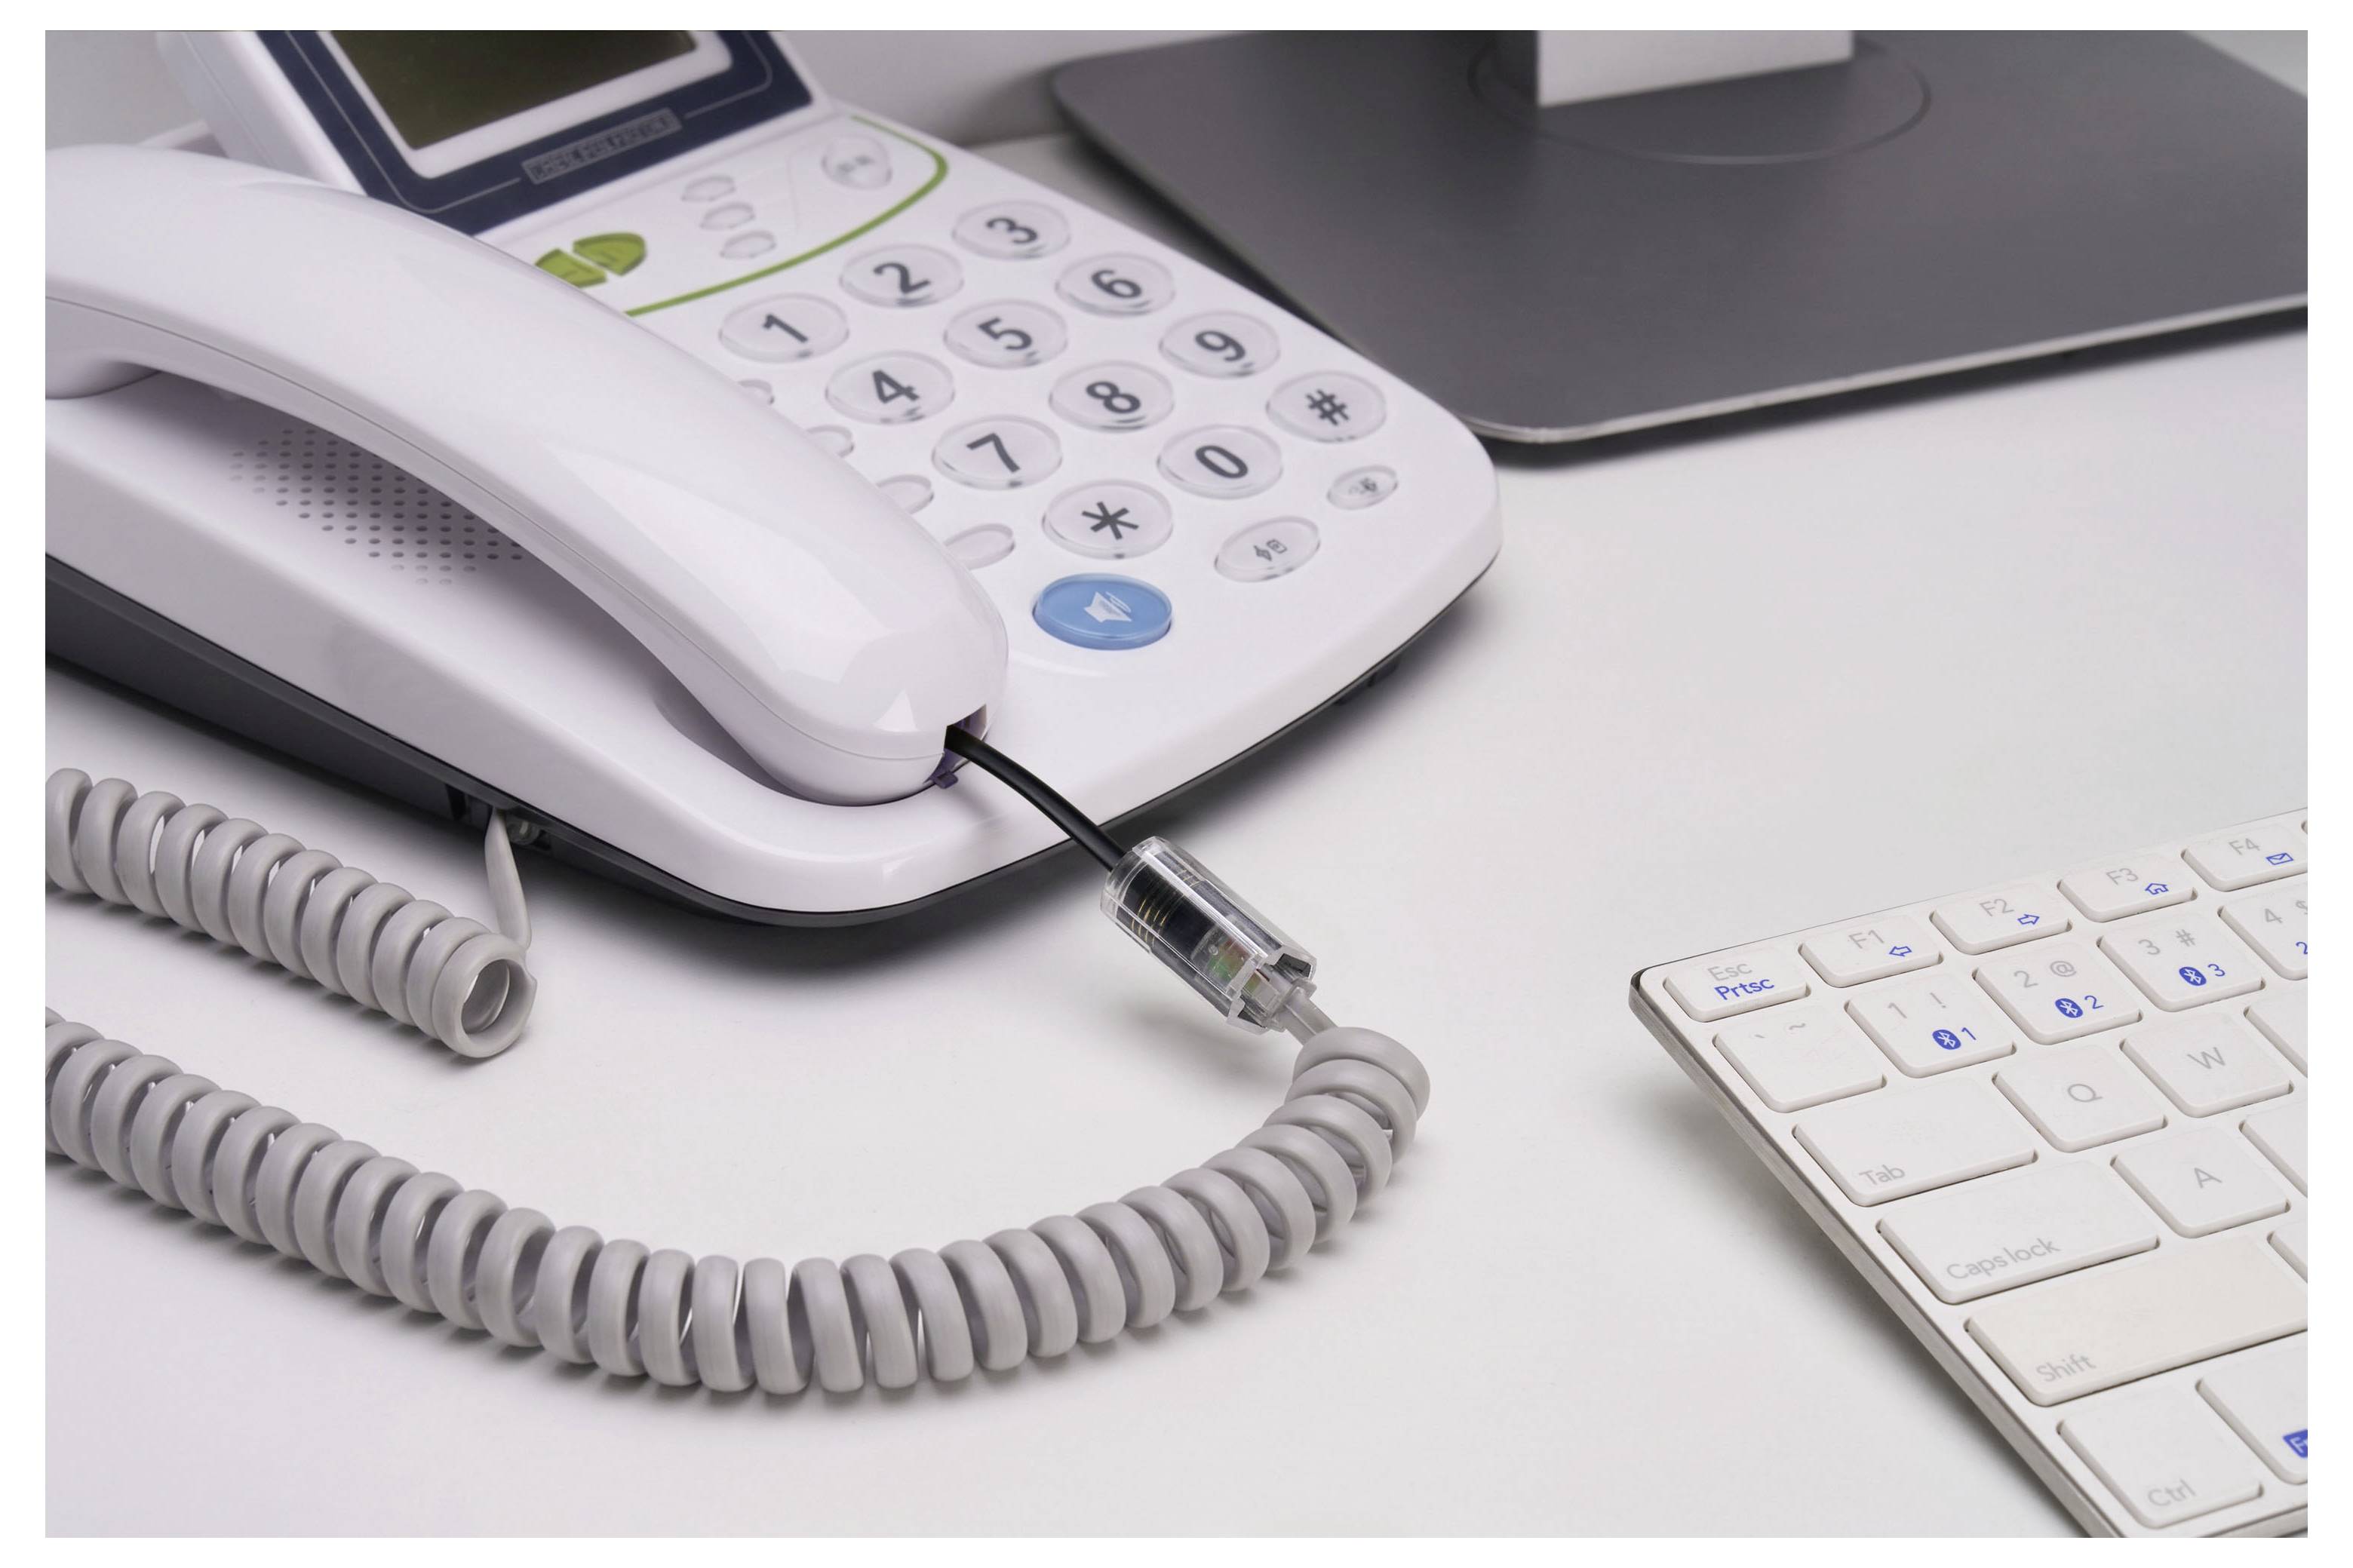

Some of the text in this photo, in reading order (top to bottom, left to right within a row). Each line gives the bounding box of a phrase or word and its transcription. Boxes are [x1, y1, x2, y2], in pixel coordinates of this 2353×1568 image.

[986, 217, 1038, 244] 3
[873, 262, 930, 295] 2
[1091, 270, 1142, 299] 6
[763, 314, 808, 343] 1
[978, 317, 1033, 351] 5
[1195, 330, 1246, 362] 9
[872, 370, 920, 404] 4
[1086, 381, 1141, 414] 8
[1307, 390, 1349, 426] #
[966, 432, 1021, 473] 7
[1195, 445, 1249, 479] 0
[2228, 838, 2260, 855] F4
[2106, 867, 2139, 885] F3
[1979, 898, 2015, 918] F2
[2264, 908, 2283, 924] 4
[1848, 929, 1885, 950] F1
[2138, 928, 2195, 956] 3 #
[1707, 963, 1752, 982] Esc
[2014, 959, 2077, 989] 2 @
[2207, 963, 2226, 977] 3
[1714, 979, 1775, 1001] Prtsc
[2084, 995, 2104, 1010] 2
[1888, 992, 1946, 1019] 1 !
[1961, 1026, 1977, 1041] 1
[2186, 1046, 2226, 1069] W
[2066, 1083, 2103, 1103] Q
[1858, 1164, 1906, 1186] Tab
[2194, 1167, 2222, 1189] A
[2036, 1354, 2097, 1382] Shift
[2147, 1478, 2196, 1508] Ctrl
